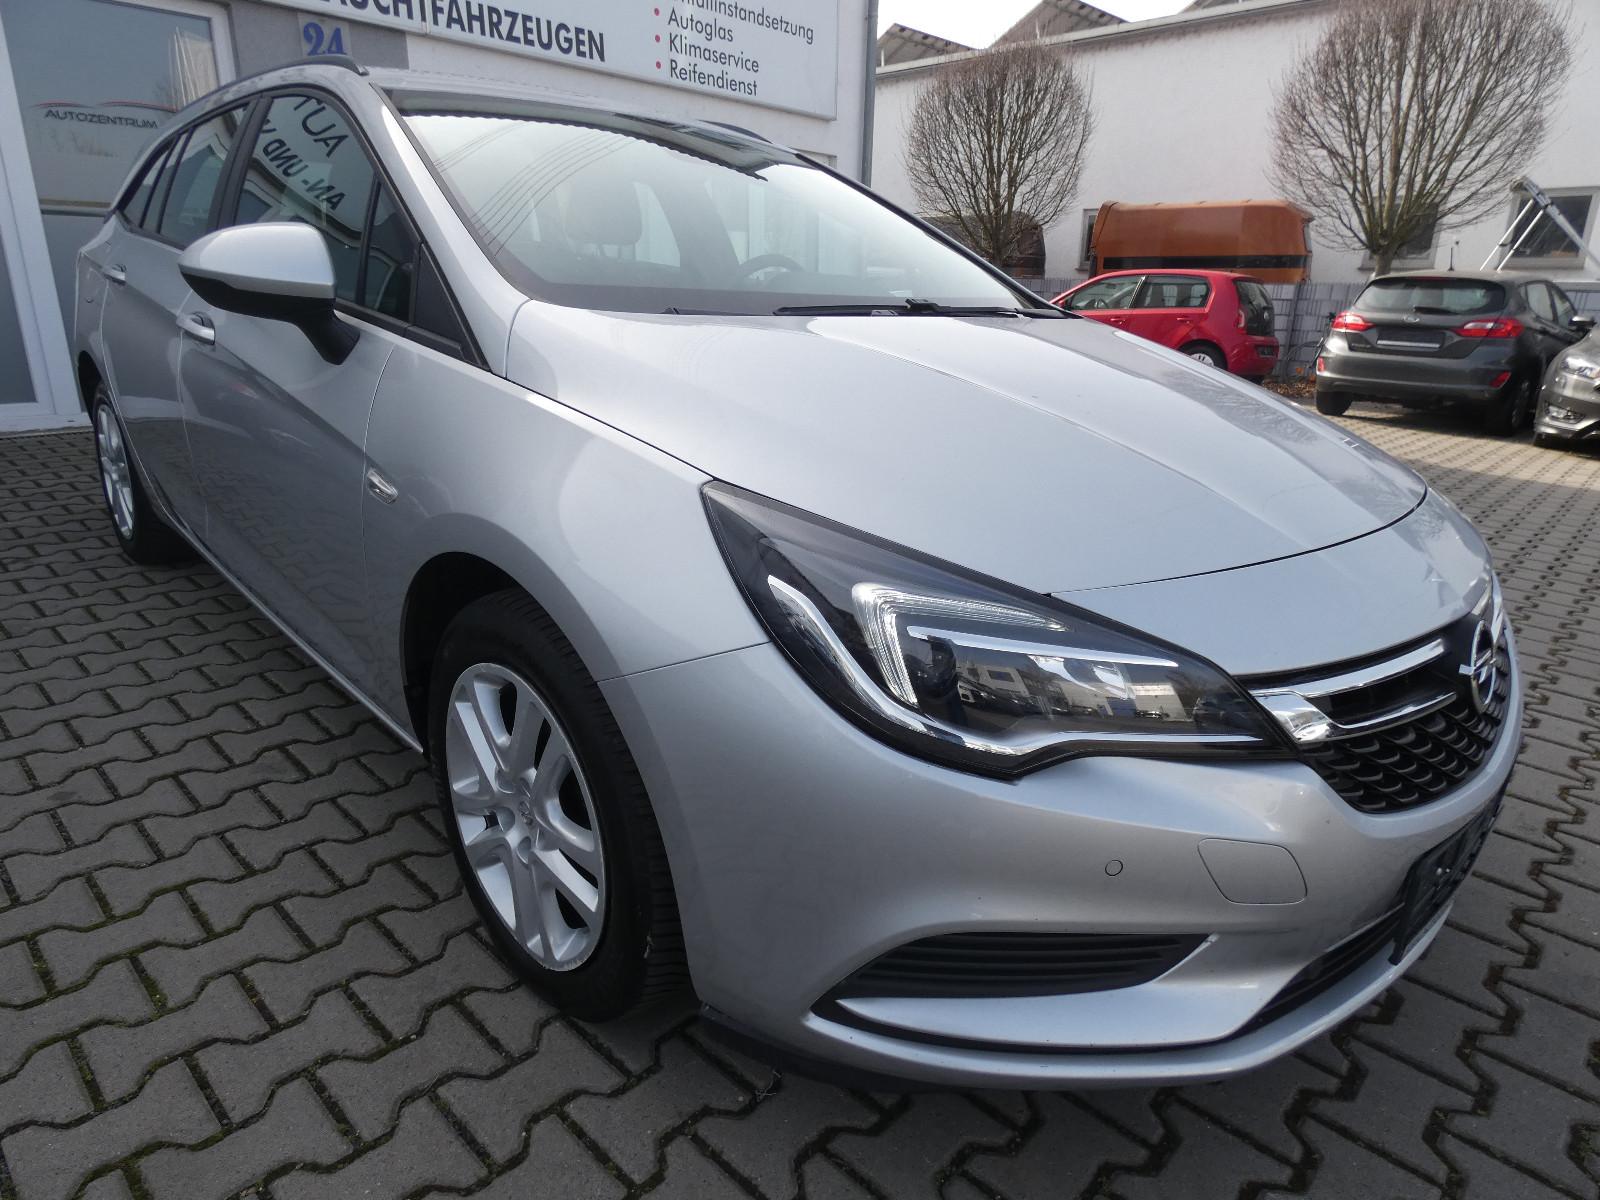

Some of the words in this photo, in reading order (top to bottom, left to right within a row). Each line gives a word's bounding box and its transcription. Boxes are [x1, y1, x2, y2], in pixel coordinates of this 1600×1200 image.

[303, 22, 347, 56] 24
[320, 0, 606, 63] CHTFAHRZEUGEN
[667, 7, 734, 43] Autoglas
[676, 0, 814, 45] allinstandsetzung
[669, 32, 759, 73] Klimaservice
[670, 59, 758, 96] Reifendienst
[44, 109, 159, 129] AUTOZENTRUM
